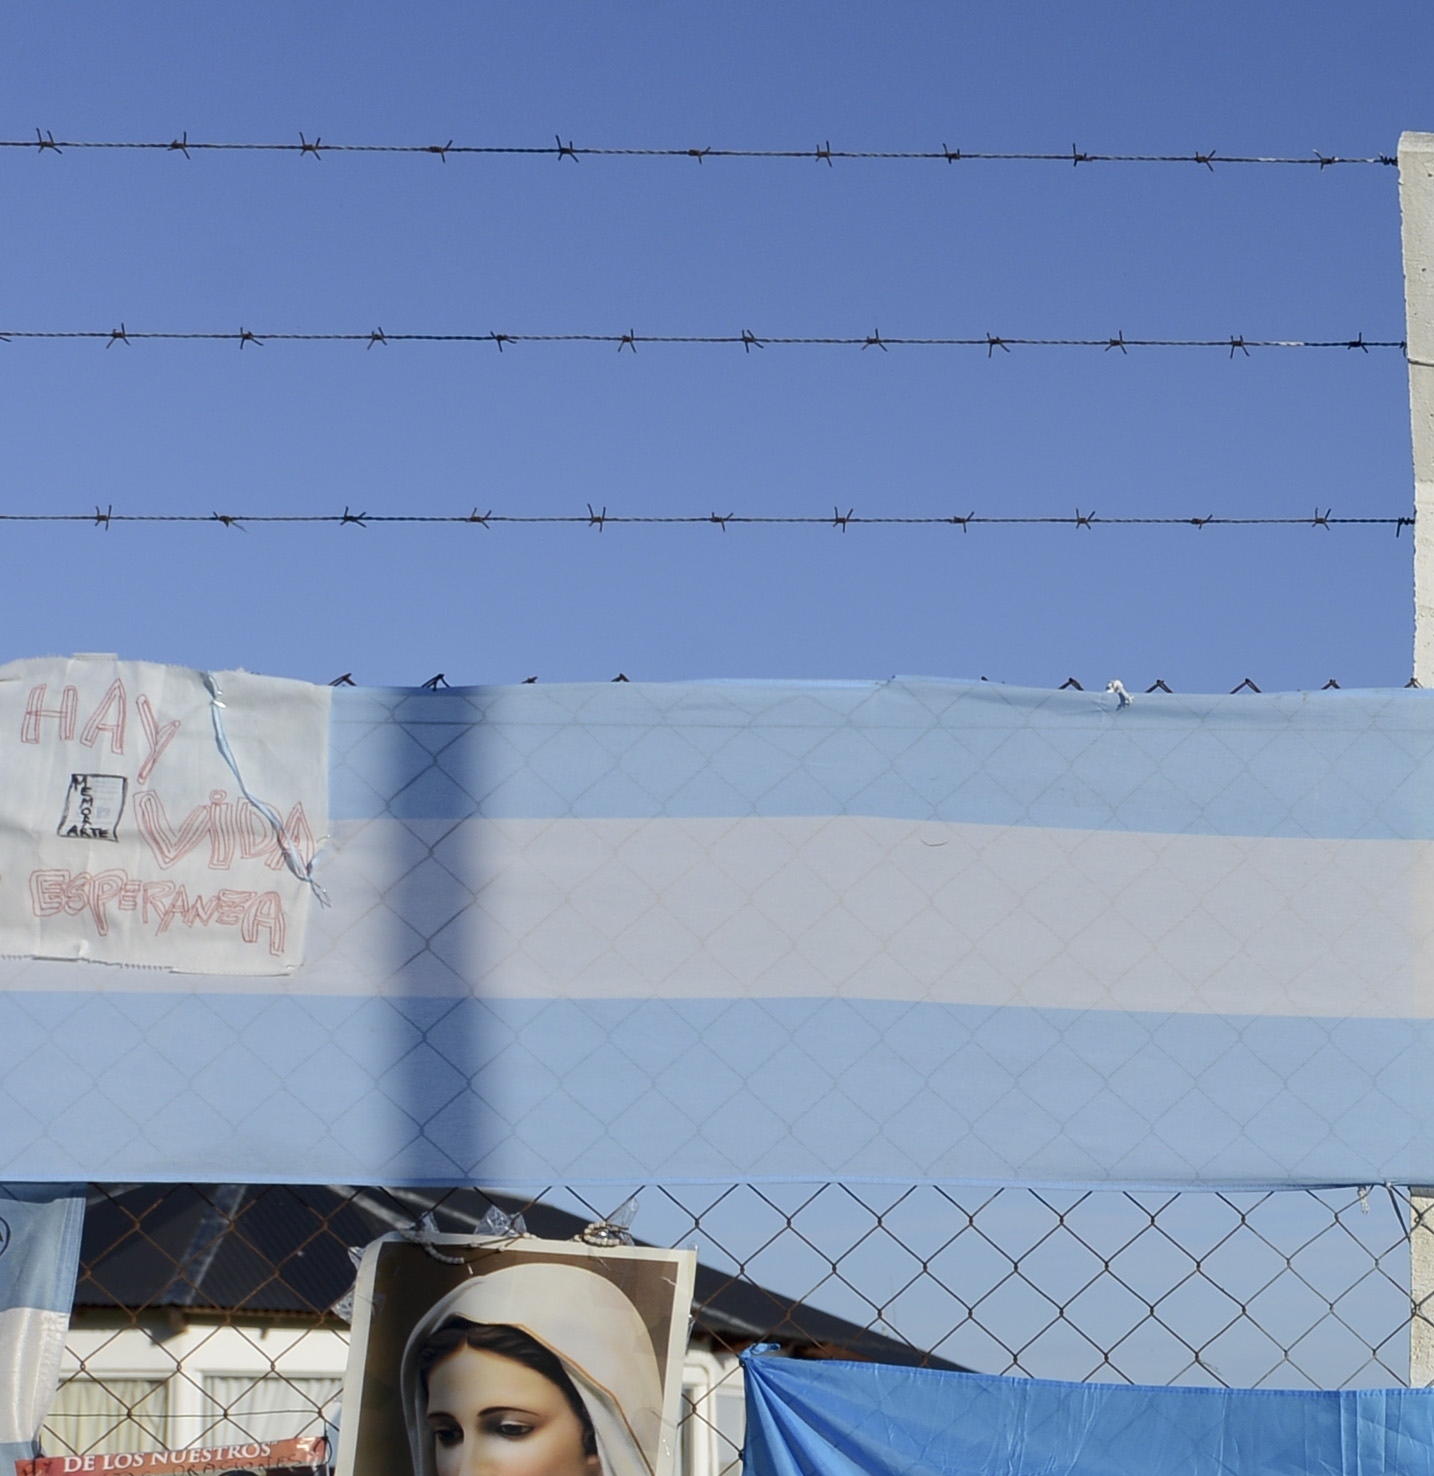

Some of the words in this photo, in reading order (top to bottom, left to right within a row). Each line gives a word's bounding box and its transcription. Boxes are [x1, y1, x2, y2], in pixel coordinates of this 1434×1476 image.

[21, 678, 181, 785] HAY
[63, 1456, 96, 1473] DE
[101, 1452, 144, 1471] LOS
